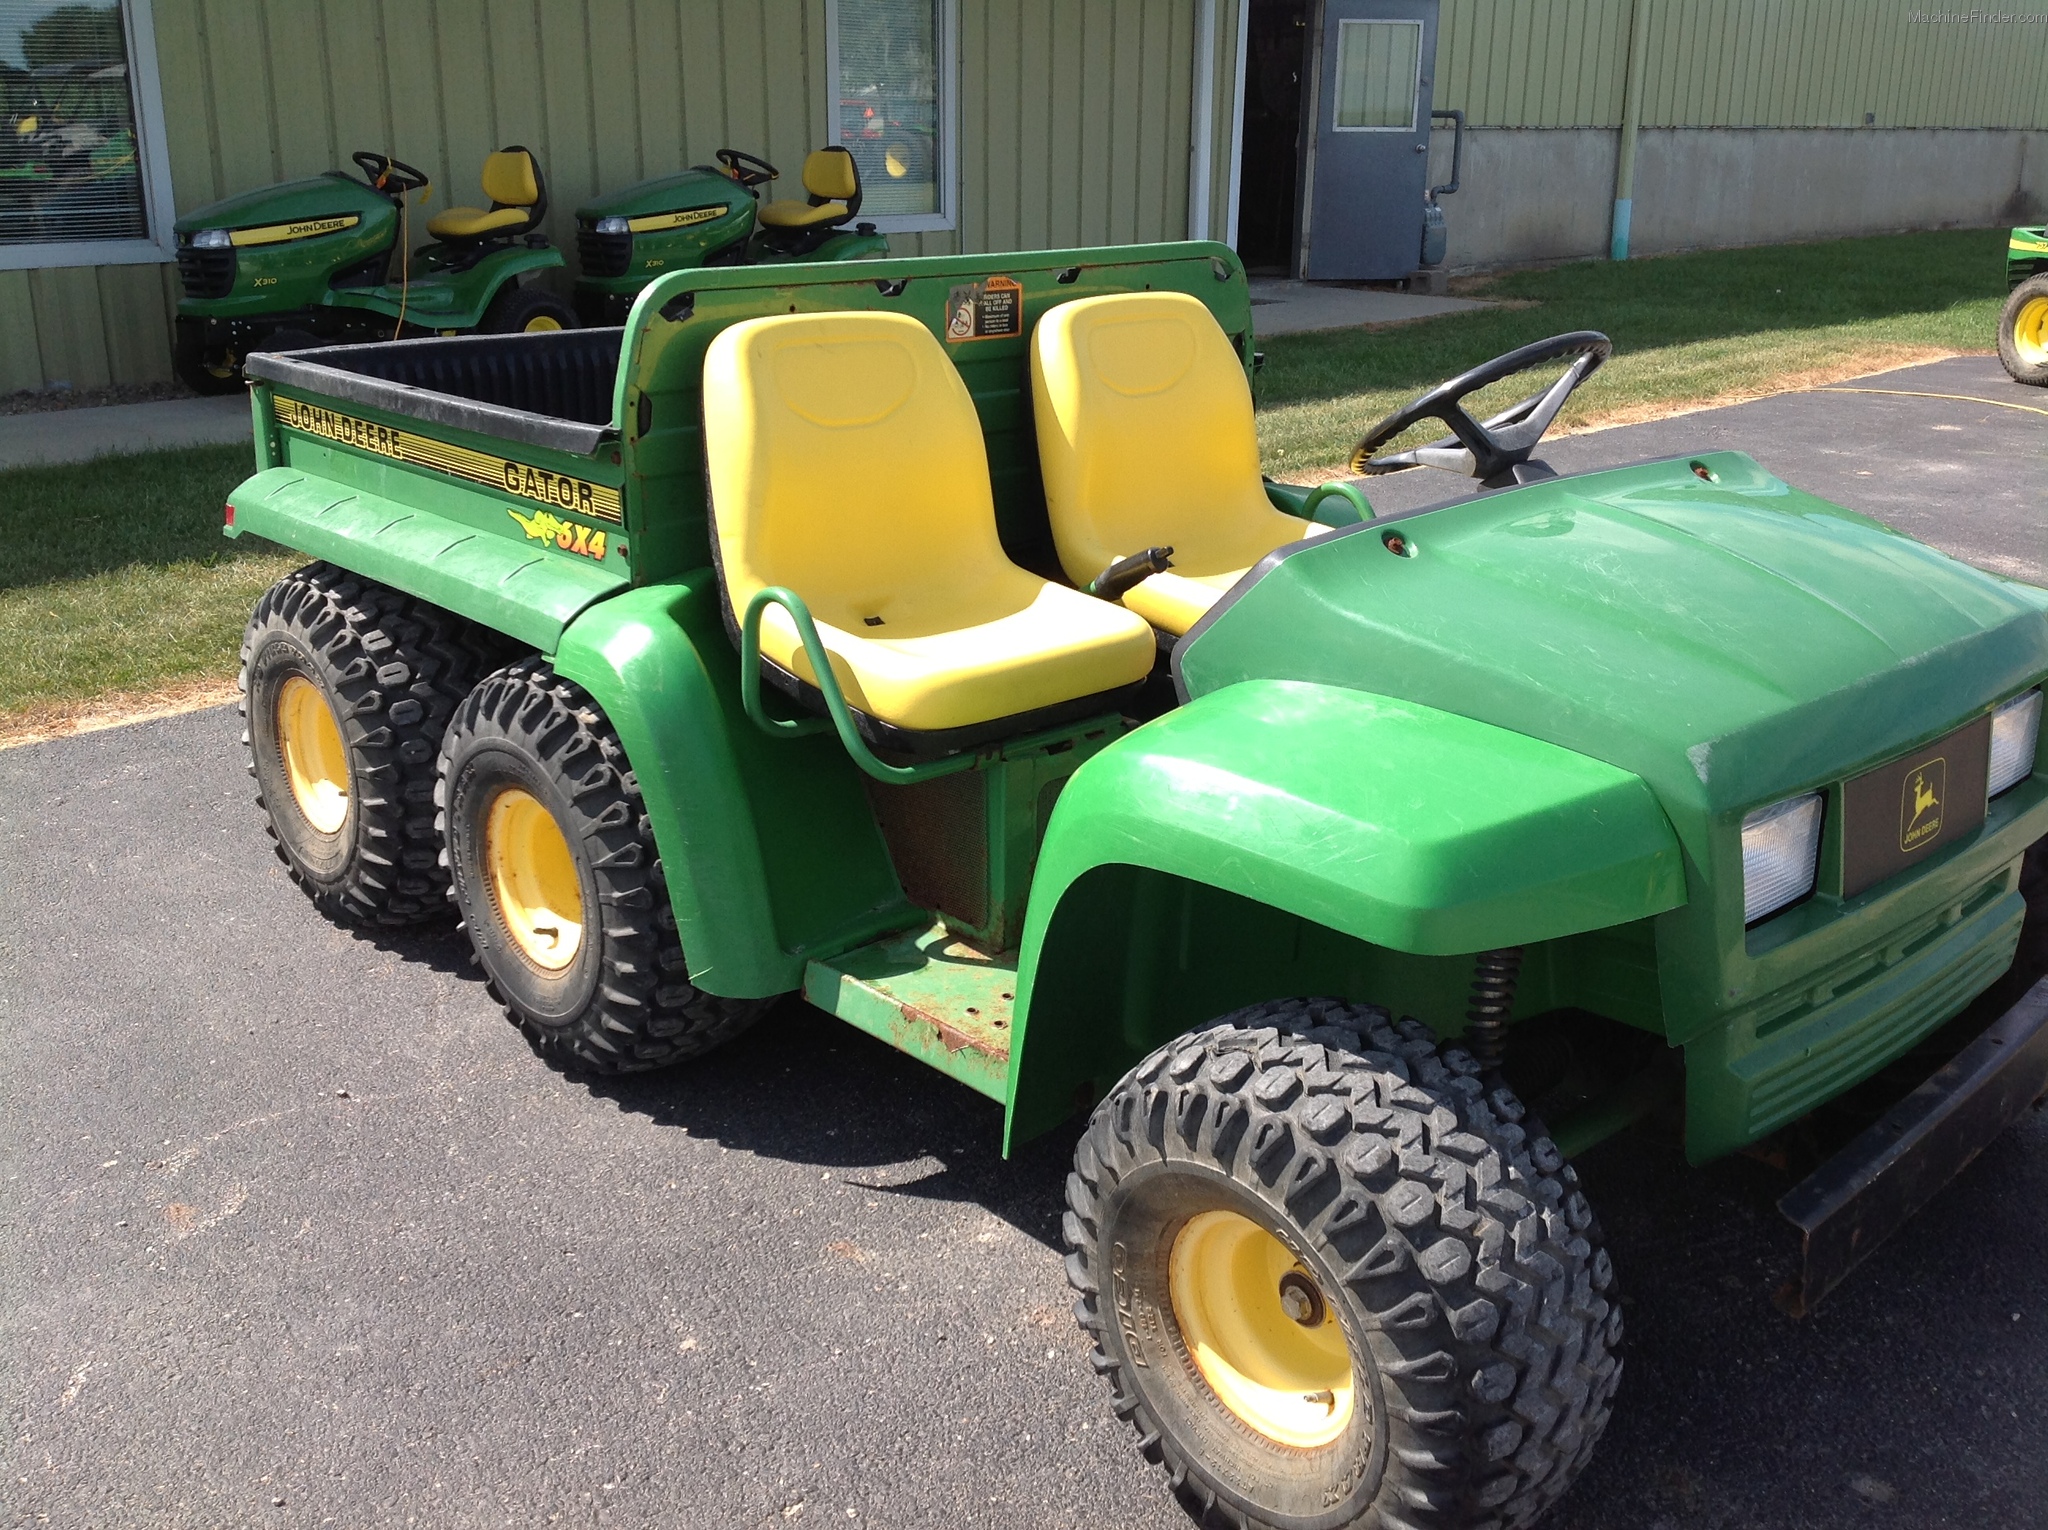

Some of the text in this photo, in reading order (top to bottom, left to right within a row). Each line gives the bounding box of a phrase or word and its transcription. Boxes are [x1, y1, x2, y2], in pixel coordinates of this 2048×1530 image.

[673, 209, 717, 223] JOHN DEERE
[286, 219, 345, 236] JOHN DEERE
[645, 259, 665, 269] X310
[253, 277, 278, 288] X310
[290, 402, 403, 460] JOHN DEERE
[503, 461, 598, 518] GATOR
[556, 519, 607, 561] 6X4
[1904, 817, 1940, 845] JOHN DEERE
